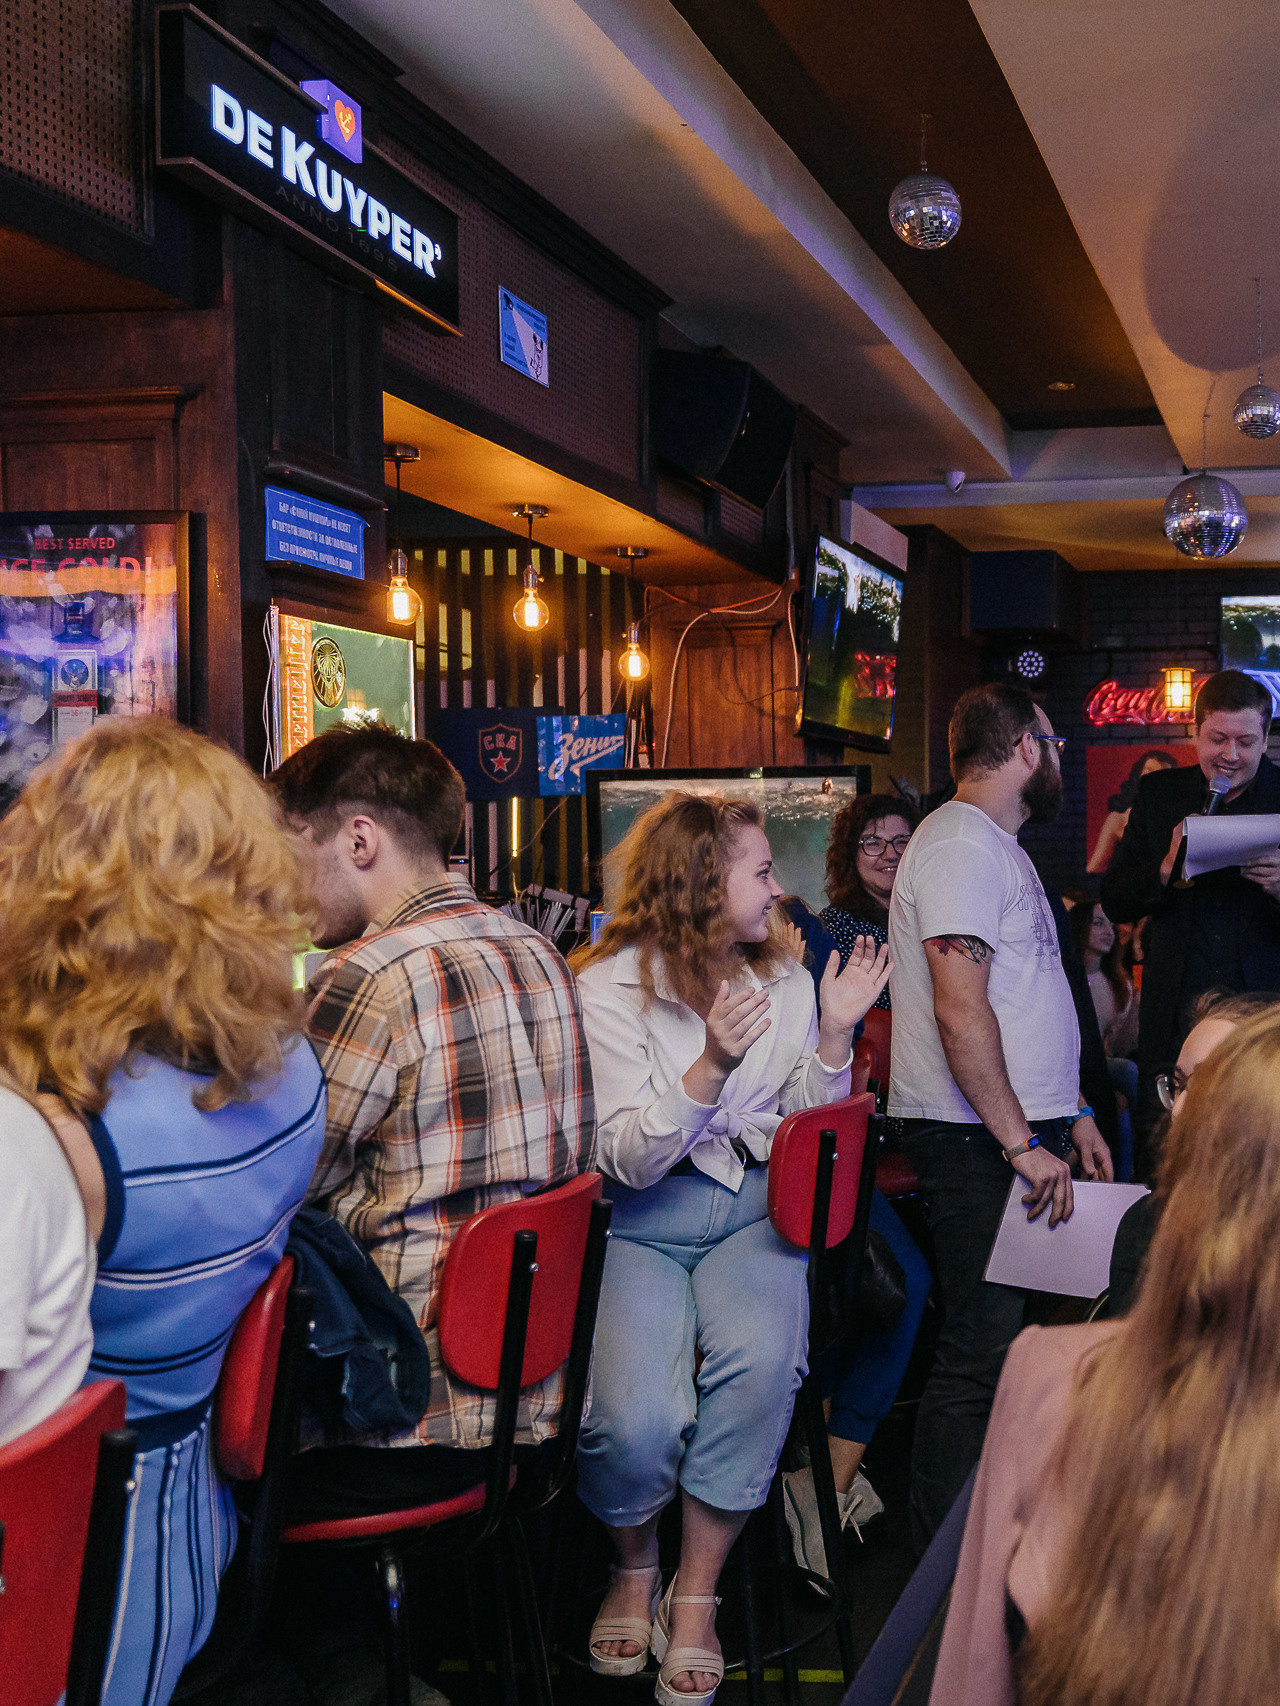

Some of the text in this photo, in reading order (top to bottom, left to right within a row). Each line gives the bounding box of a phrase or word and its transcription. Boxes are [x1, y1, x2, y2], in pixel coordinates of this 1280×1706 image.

[211, 83, 274, 169] DE
[276, 185, 399, 272] ANNO 1695
[34, 537, 116, 550] BEST SERVED
[483, 733, 517, 751] СКА
[547, 732, 625, 781] Зенит
